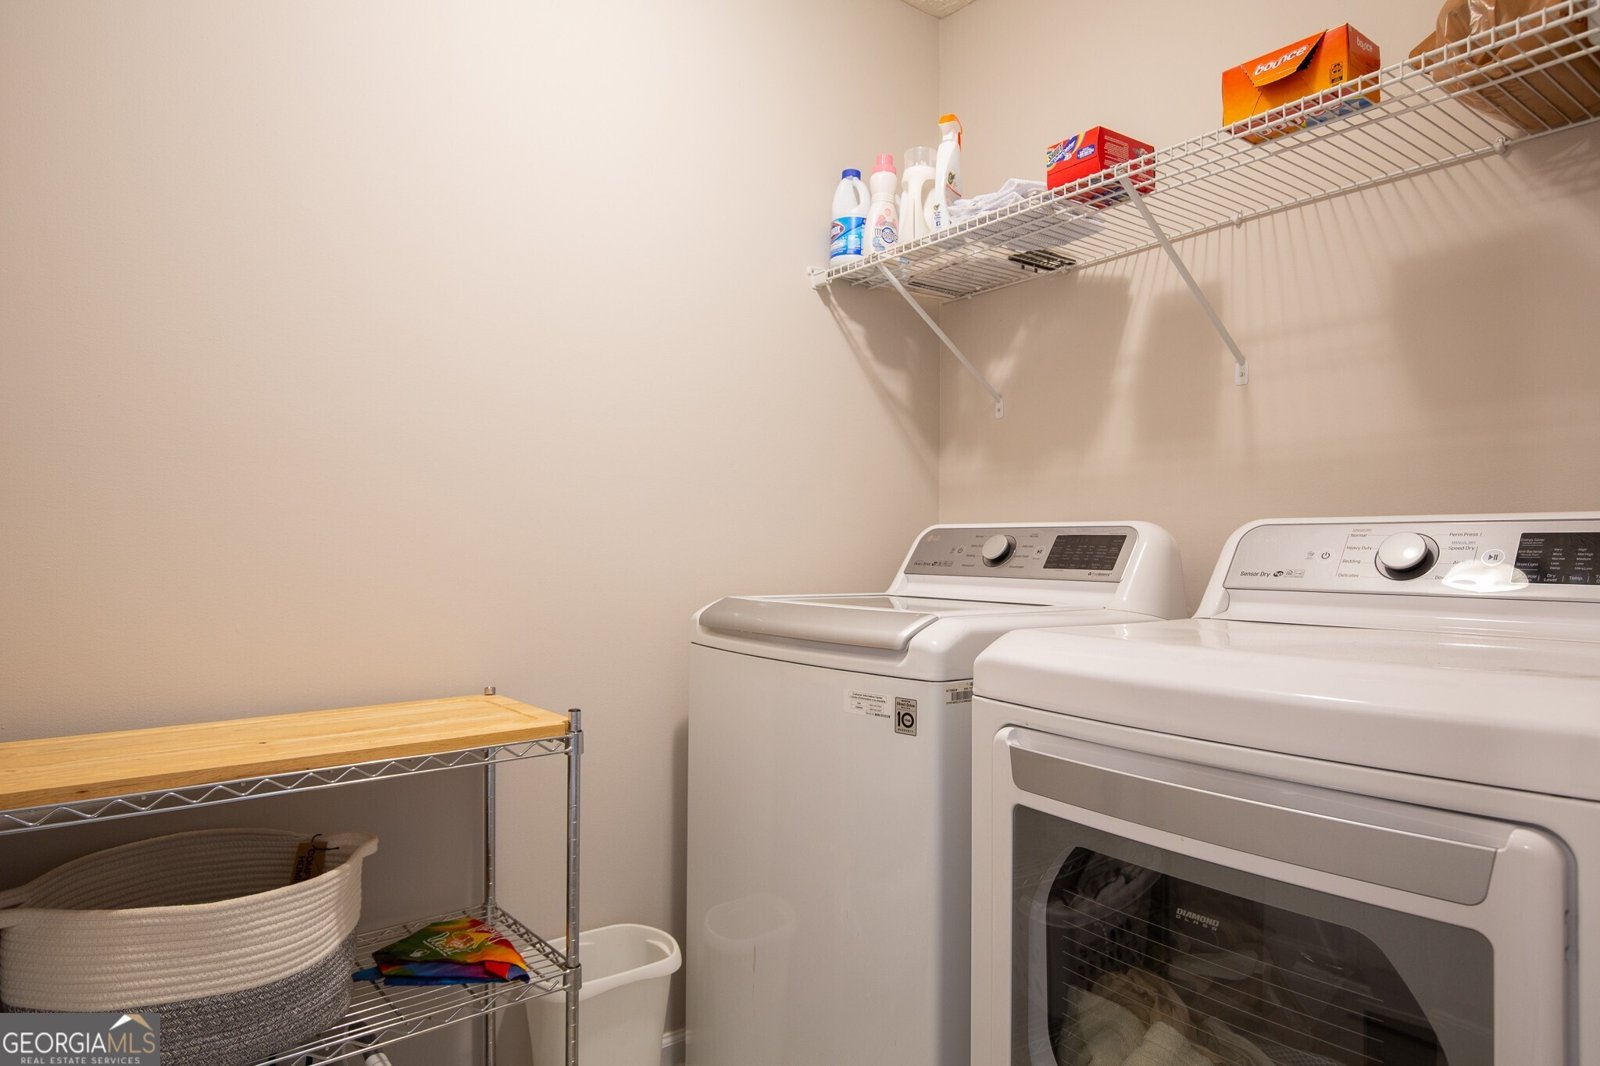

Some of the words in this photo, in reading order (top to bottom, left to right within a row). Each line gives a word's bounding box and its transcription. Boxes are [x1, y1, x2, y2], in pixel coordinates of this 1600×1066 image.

[1254, 45, 1308, 76] bounce
[1260, 570, 1271, 579] Dry
[896, 710, 915, 728] 10
[1176, 908, 1220, 927] DIAMOND
